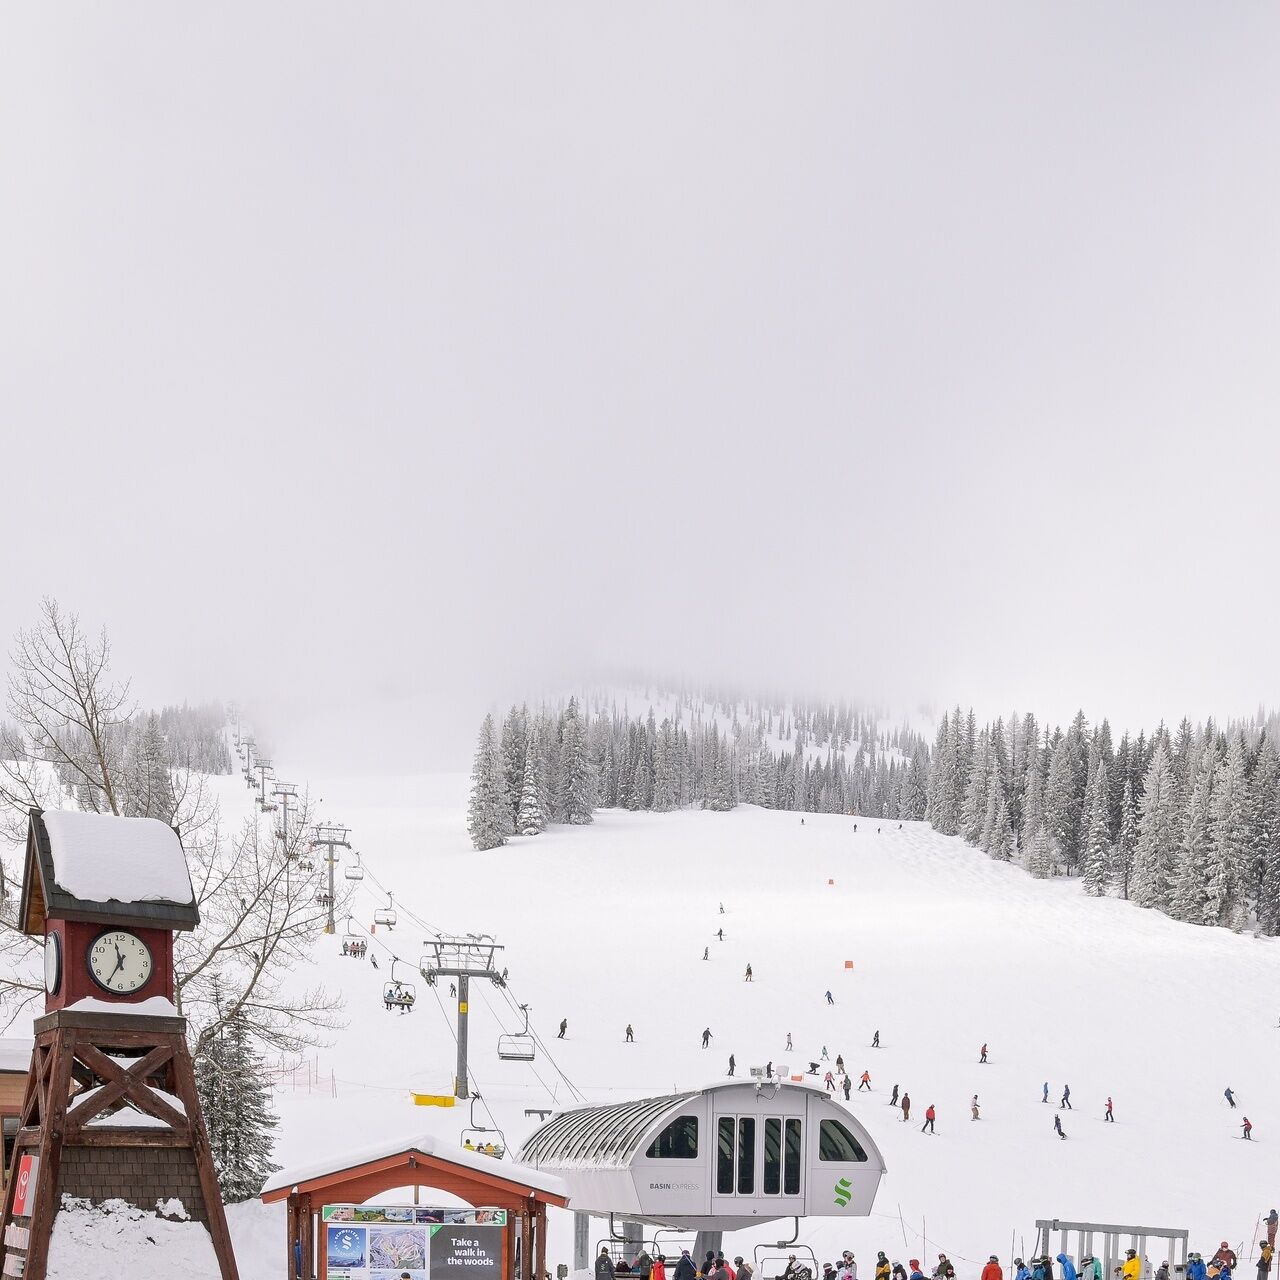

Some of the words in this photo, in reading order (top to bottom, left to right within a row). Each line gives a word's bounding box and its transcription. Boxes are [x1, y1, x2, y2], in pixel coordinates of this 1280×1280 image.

[115, 934, 125, 942] 12
[94, 946, 105, 954] 10
[91, 956, 98, 964] 9
[451, 1238, 473, 1247] Take
[454, 1248, 476, 1257] walk
[477, 1249, 486, 1257] in
[447, 1257, 463, 1265] the
[464, 1257, 494, 1266] woods
